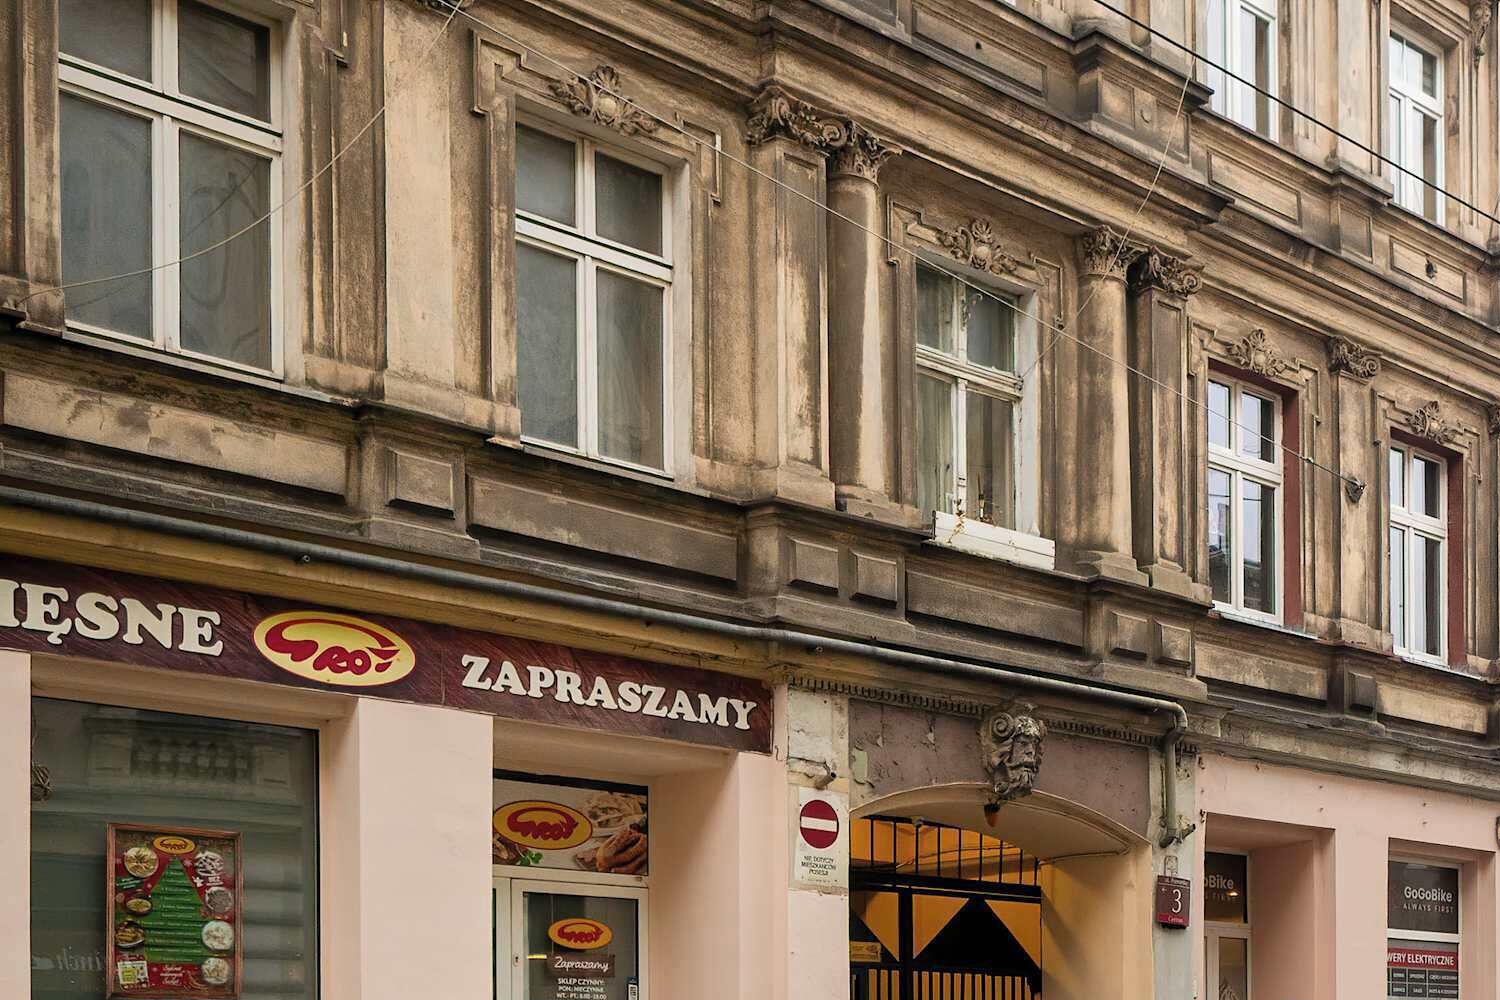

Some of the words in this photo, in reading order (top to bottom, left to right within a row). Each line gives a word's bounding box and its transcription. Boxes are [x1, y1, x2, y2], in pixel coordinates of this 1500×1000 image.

[462, 654, 757, 730] ZAPRASZAMY
[1171, 889, 1182, 913] 3
[1404, 886, 1453, 902] GoGoBike
[1403, 903, 1431, 912] ALWAYS
[1434, 905, 1454, 913] FIRST
[554, 956, 609, 973] Zapraszamy
[1408, 952, 1455, 966] ELEKTRYCZNE
